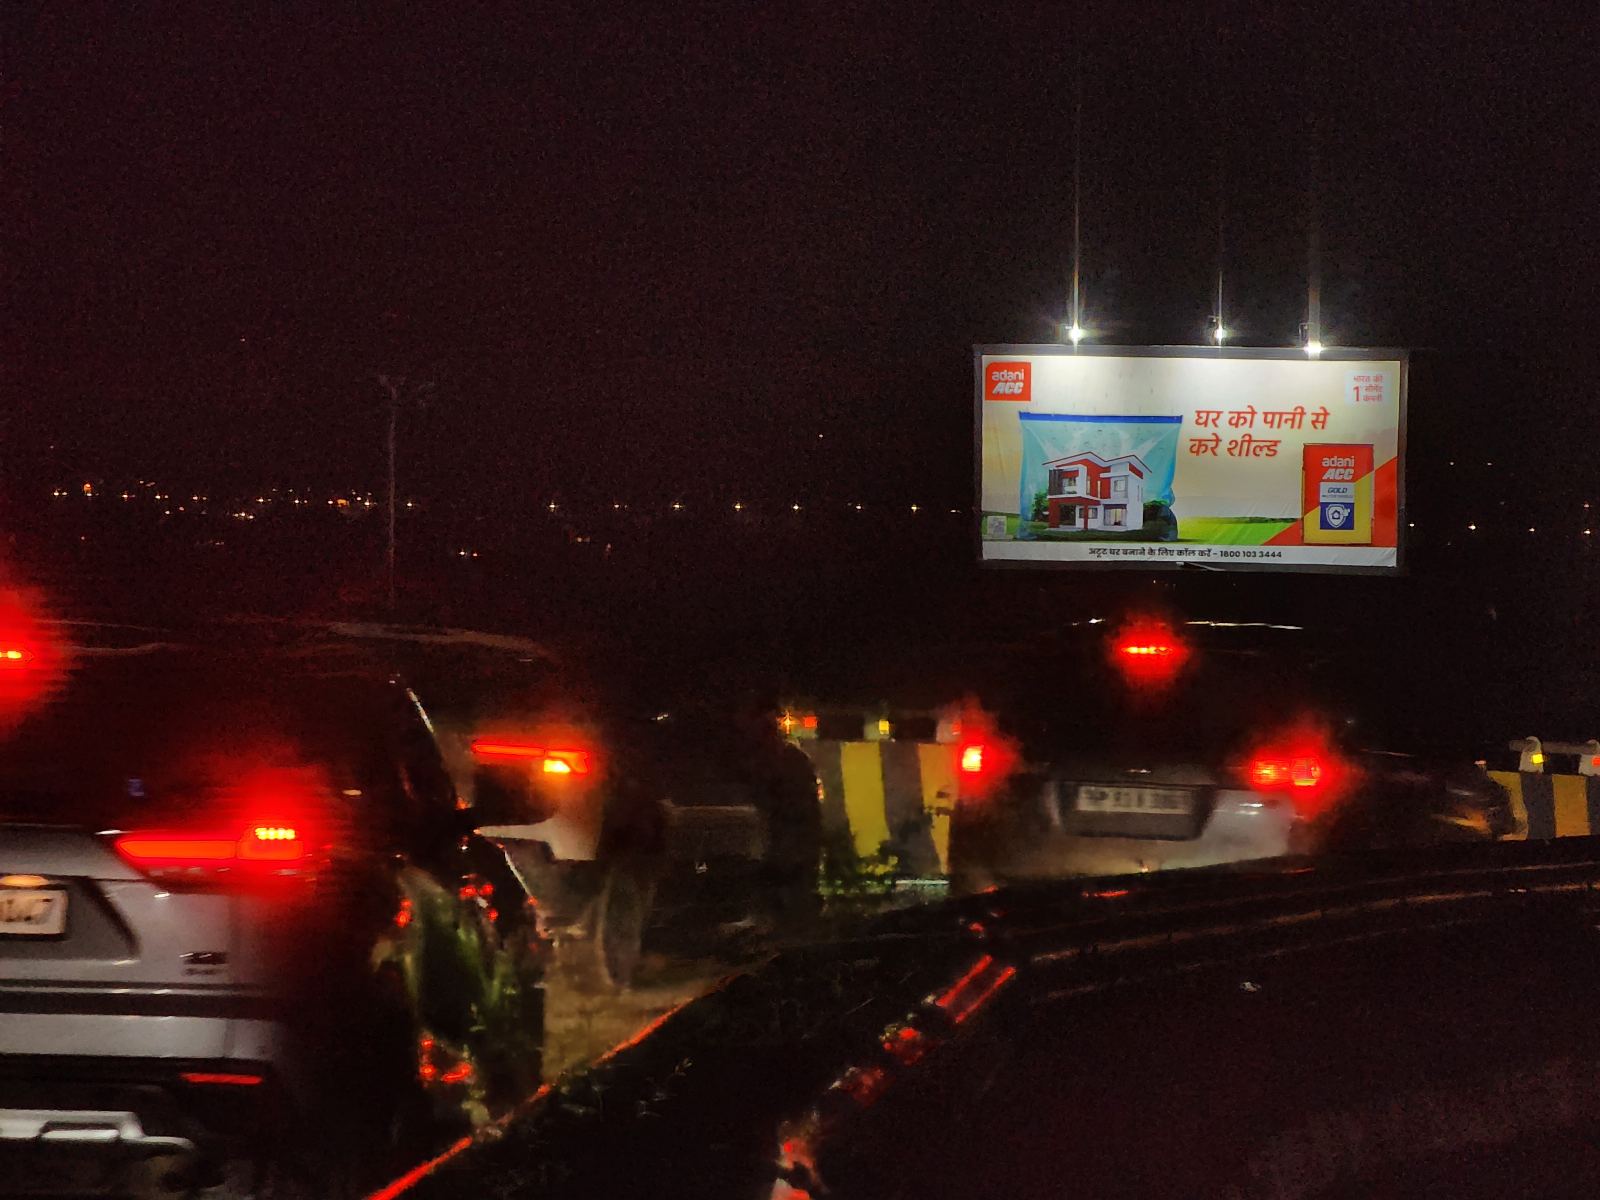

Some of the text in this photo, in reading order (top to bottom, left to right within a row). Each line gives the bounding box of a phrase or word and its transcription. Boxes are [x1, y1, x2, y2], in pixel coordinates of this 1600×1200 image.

[991, 368, 1025, 381] adani
[992, 381, 1024, 395] ACC
[1353, 385, 1360, 402] 1
[1194, 405, 1330, 430] घर को पानी से
[1188, 432, 1281, 458] करे शील्ड
[1322, 455, 1355, 468] adani
[1322, 468, 1355, 480] ACC
[1109, 547, 1120, 556] घर
[1121, 546, 1146, 557] बनाने
[1147, 546, 1156, 556] के
[1157, 546, 1175, 557] लिए
[1176, 546, 1197, 557] कॉल
[1220, 550, 1240, 558] 1800
[1242, 550, 1257, 558] 103
